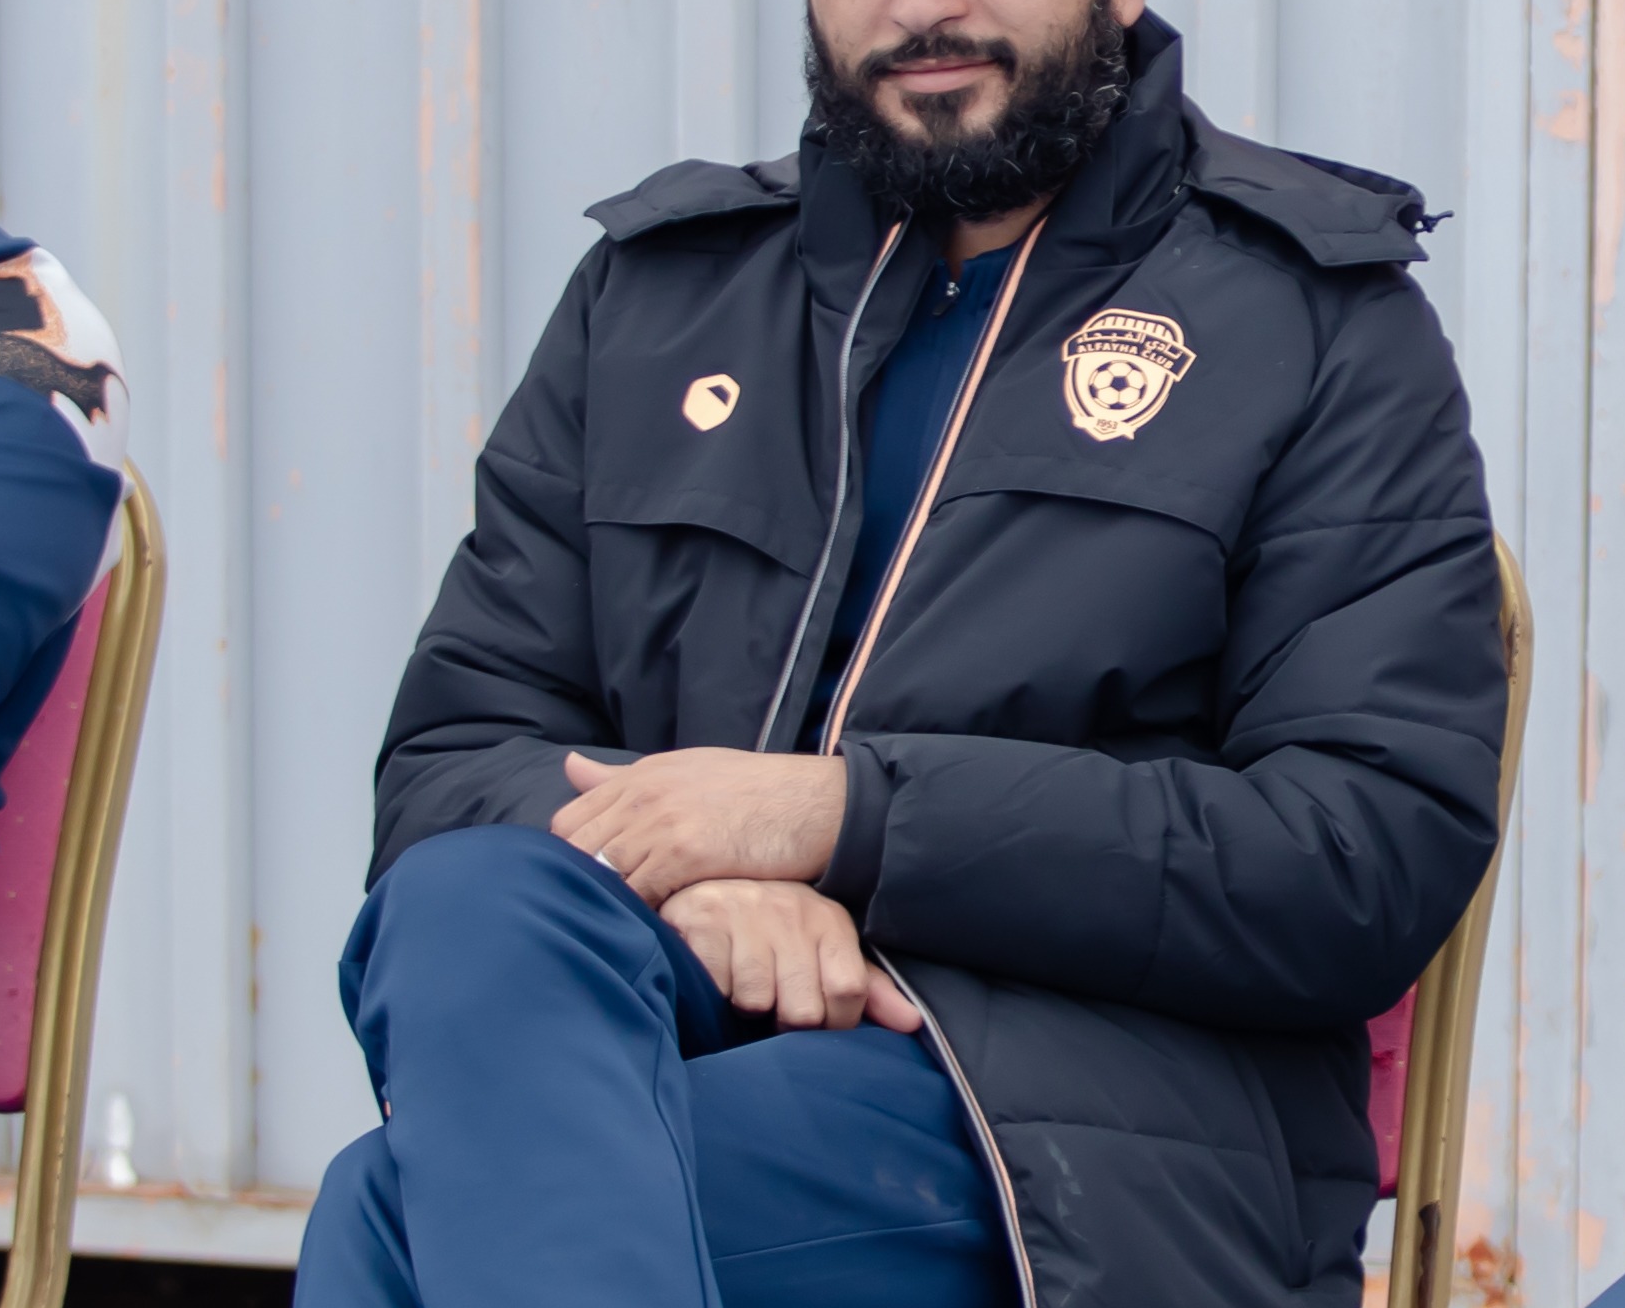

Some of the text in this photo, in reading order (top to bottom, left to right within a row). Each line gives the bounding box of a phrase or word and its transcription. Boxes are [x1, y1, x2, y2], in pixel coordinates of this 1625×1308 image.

[1077, 331, 1183, 360] نادي الفيحاء
[1077, 342, 1174, 370] ALFAYHA CLUB
[1096, 418, 1118, 431] 1953
